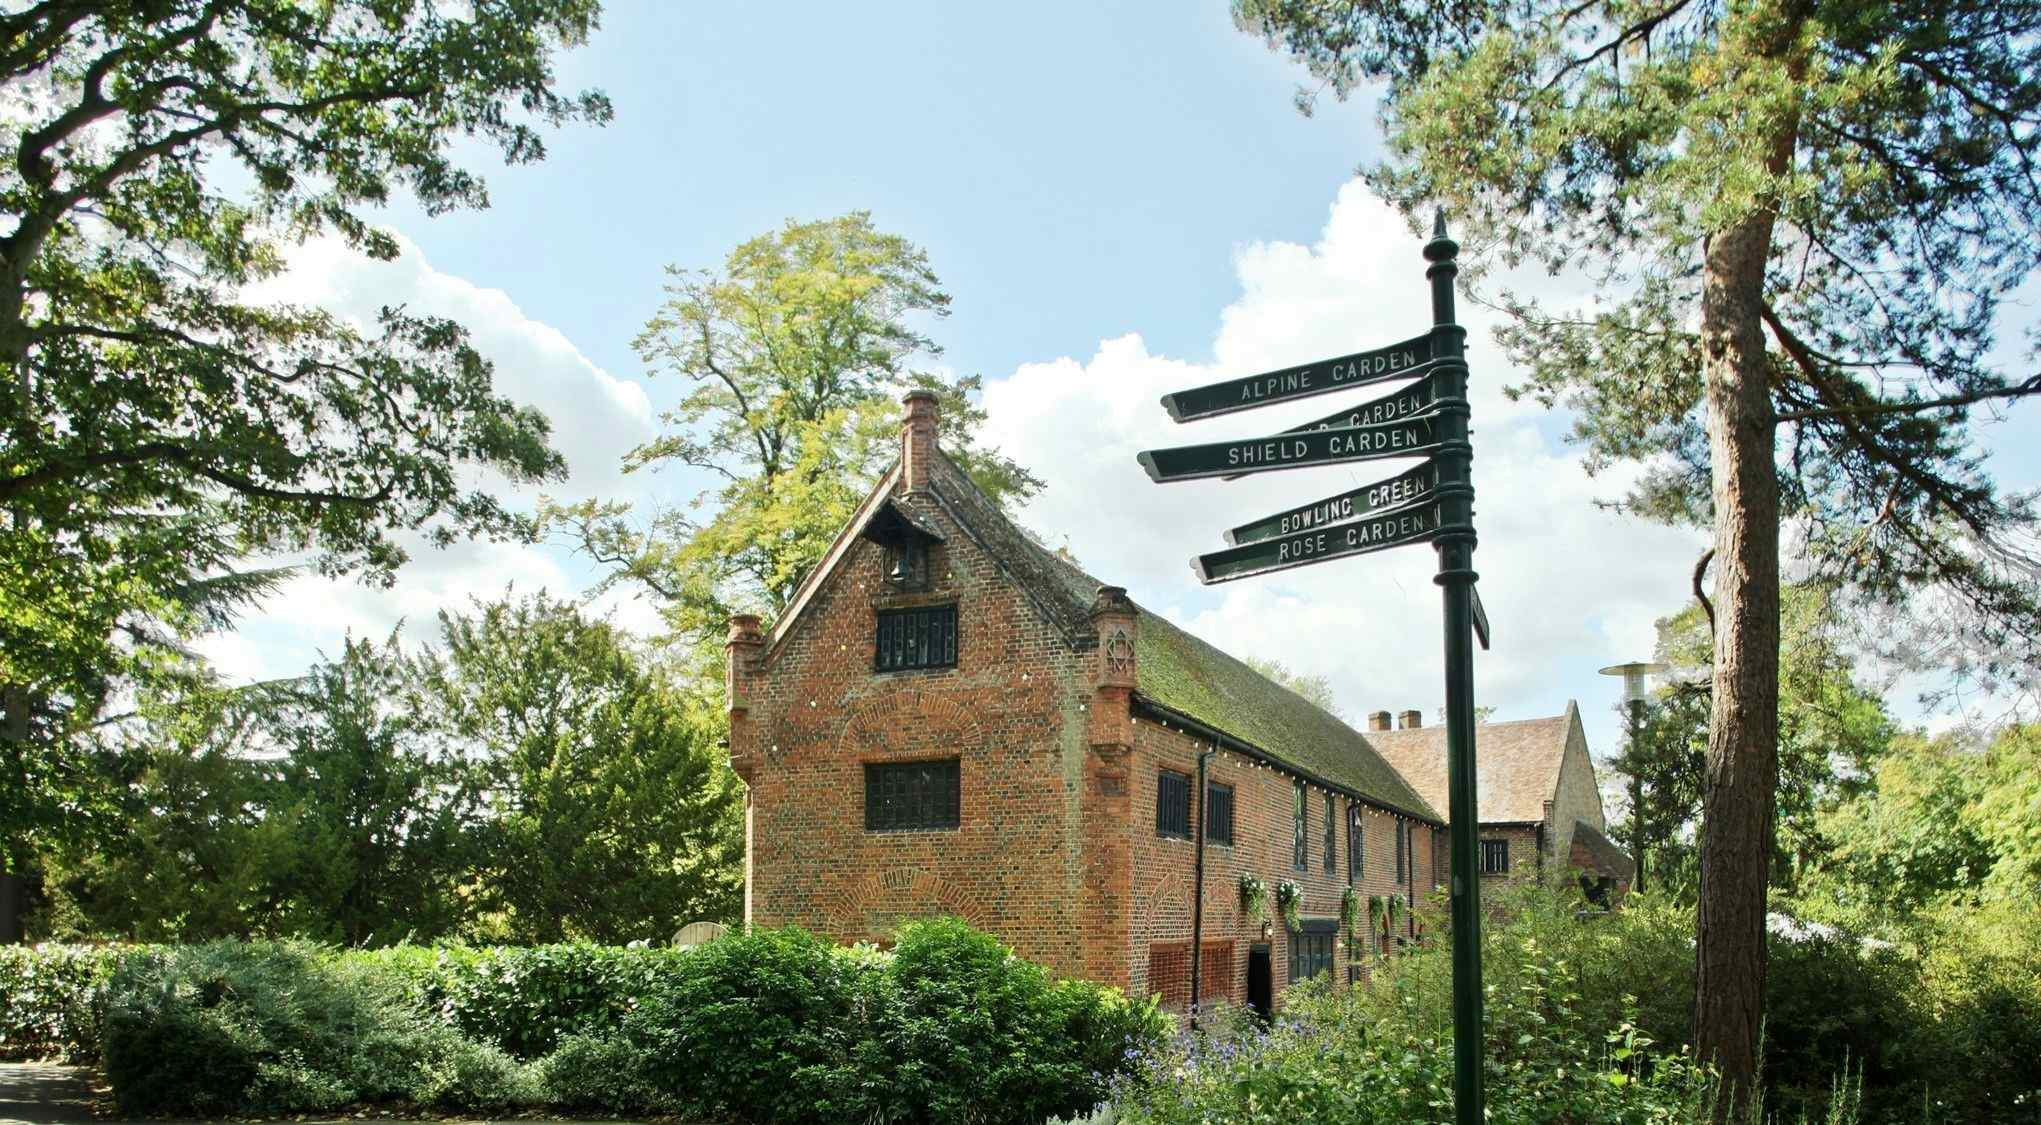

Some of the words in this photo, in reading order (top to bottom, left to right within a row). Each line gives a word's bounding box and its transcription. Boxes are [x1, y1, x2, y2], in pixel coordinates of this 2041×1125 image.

[1241, 371, 1312, 400] ALPINE
[1228, 441, 1308, 465] SHIELD
[1281, 498, 1351, 534] BOWLING
[1368, 476, 1424, 507] GREEN
[1279, 535, 1327, 560] ROSE
